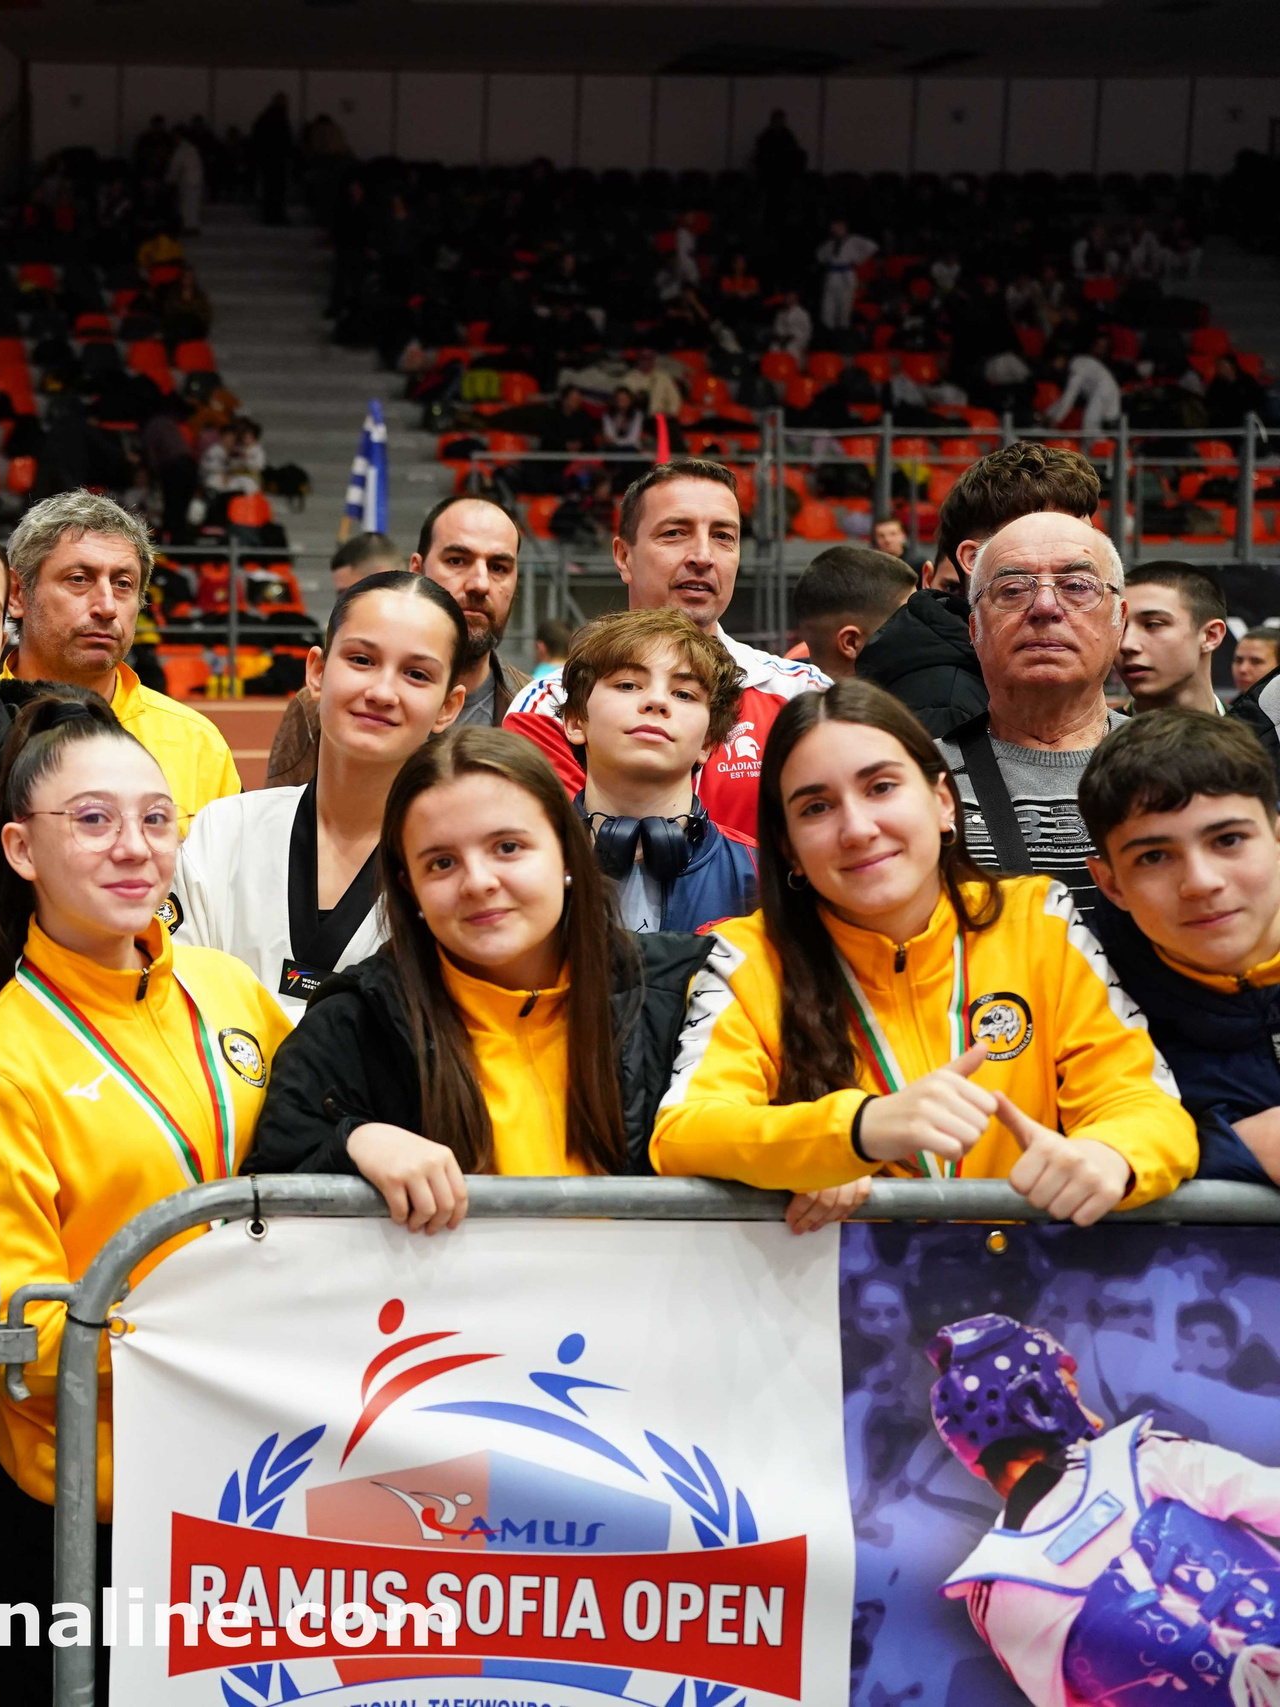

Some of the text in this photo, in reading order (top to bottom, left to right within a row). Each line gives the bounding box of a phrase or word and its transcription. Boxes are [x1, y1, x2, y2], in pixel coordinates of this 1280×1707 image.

[730, 771, 745, 779] EST
[189, 1563, 786, 1648] RAMUS SOFIA OPEN
